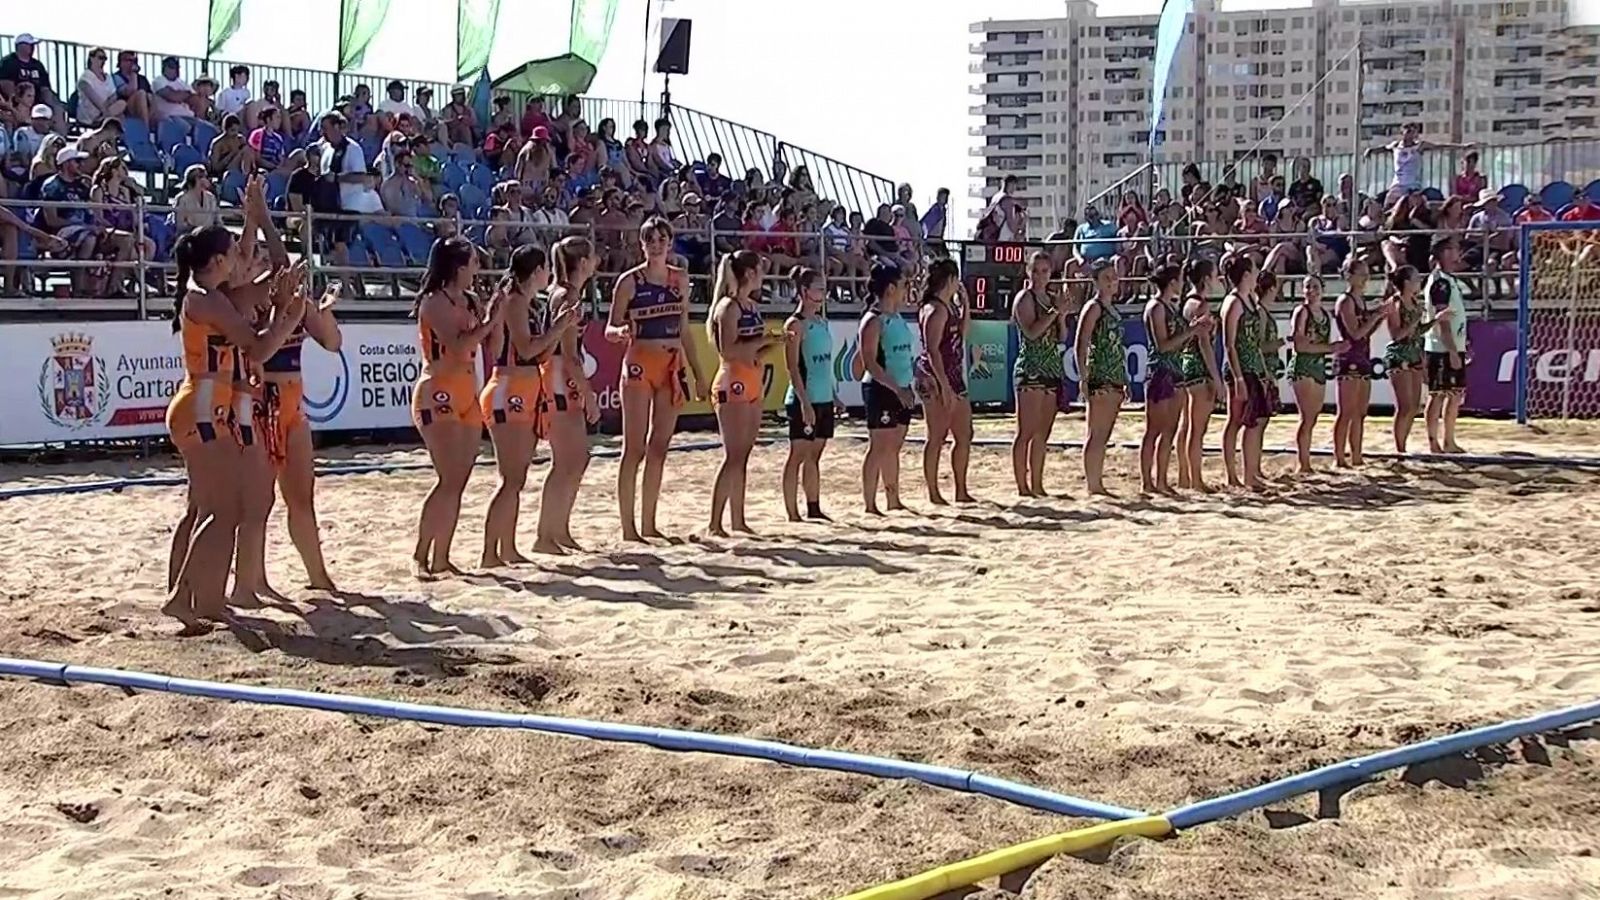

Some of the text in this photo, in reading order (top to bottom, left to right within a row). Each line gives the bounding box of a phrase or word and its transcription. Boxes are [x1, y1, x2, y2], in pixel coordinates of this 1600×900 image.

[359, 343, 416, 356] Costa Cálida
[362, 387, 386, 408] DE
